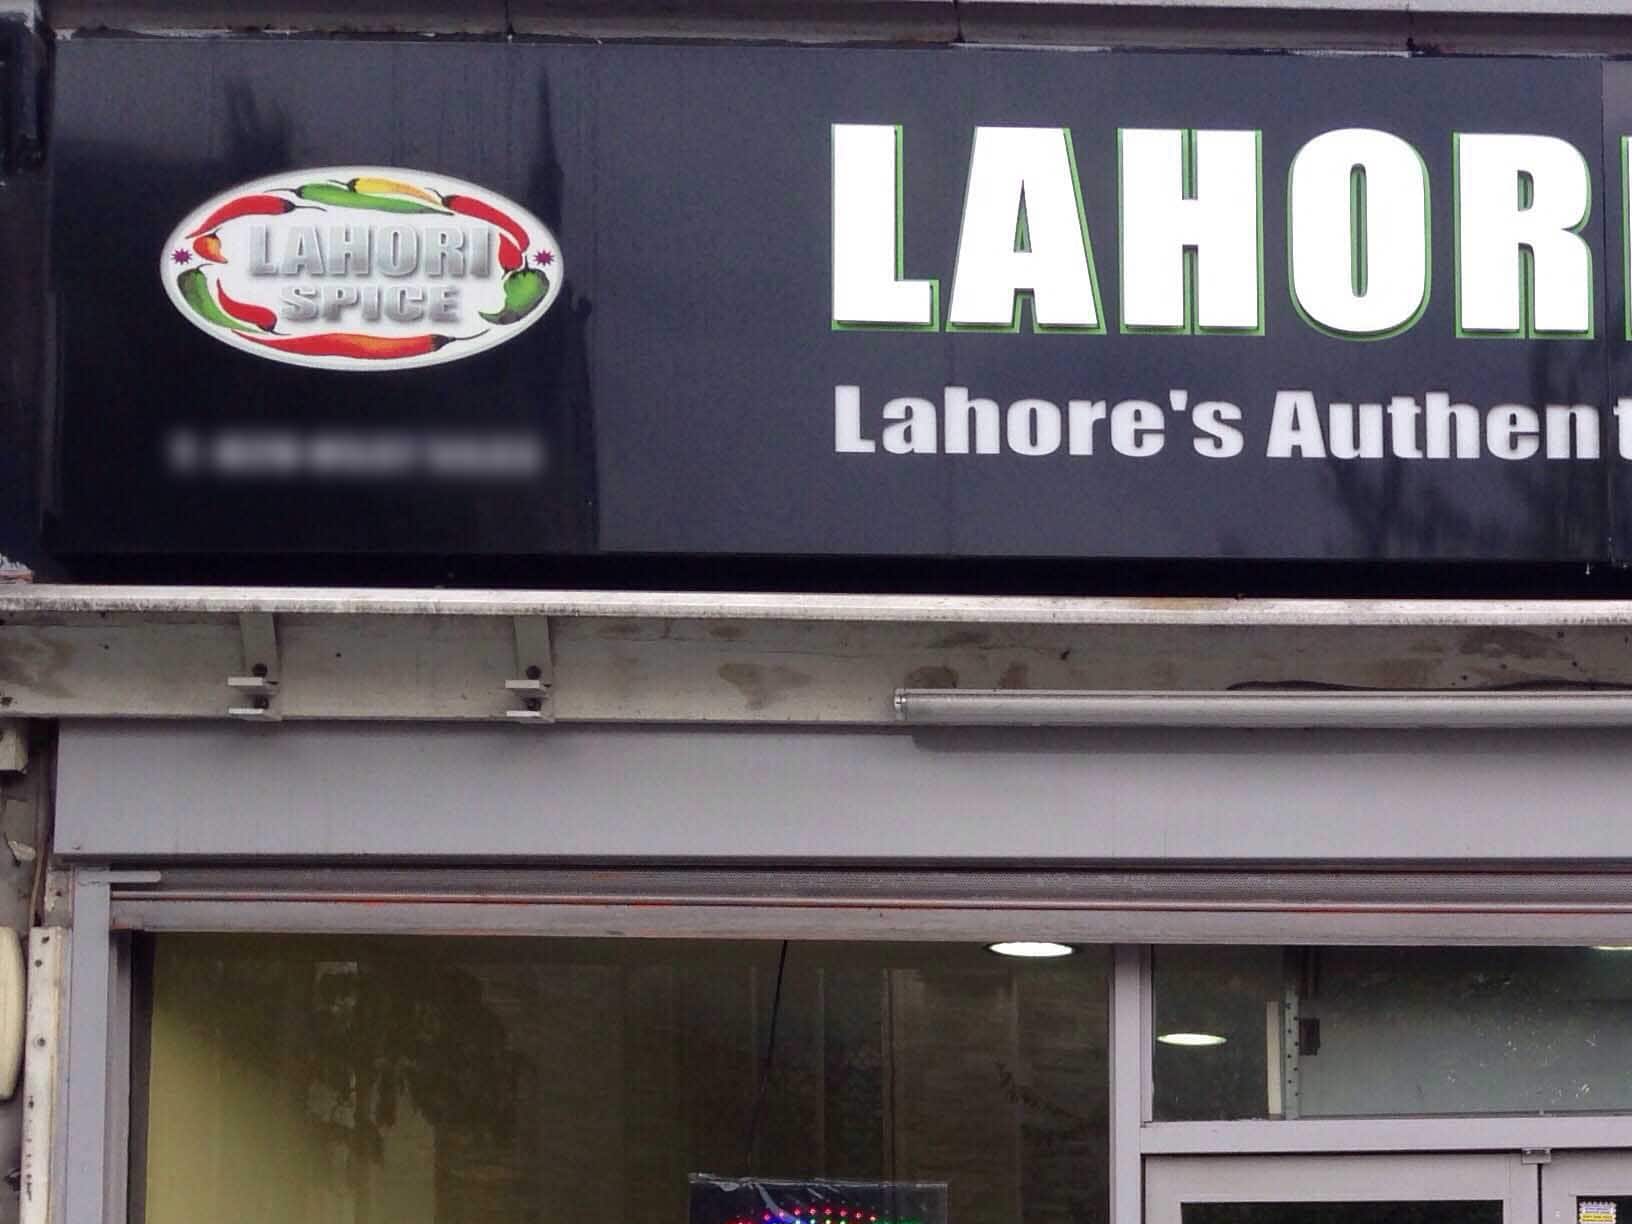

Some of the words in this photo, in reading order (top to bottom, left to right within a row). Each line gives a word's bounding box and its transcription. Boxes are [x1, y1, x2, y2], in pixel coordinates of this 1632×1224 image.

[249, 223, 492, 279] LAHORI
[280, 285, 461, 325] SPICE
[833, 385, 1244, 458] Lahore's
